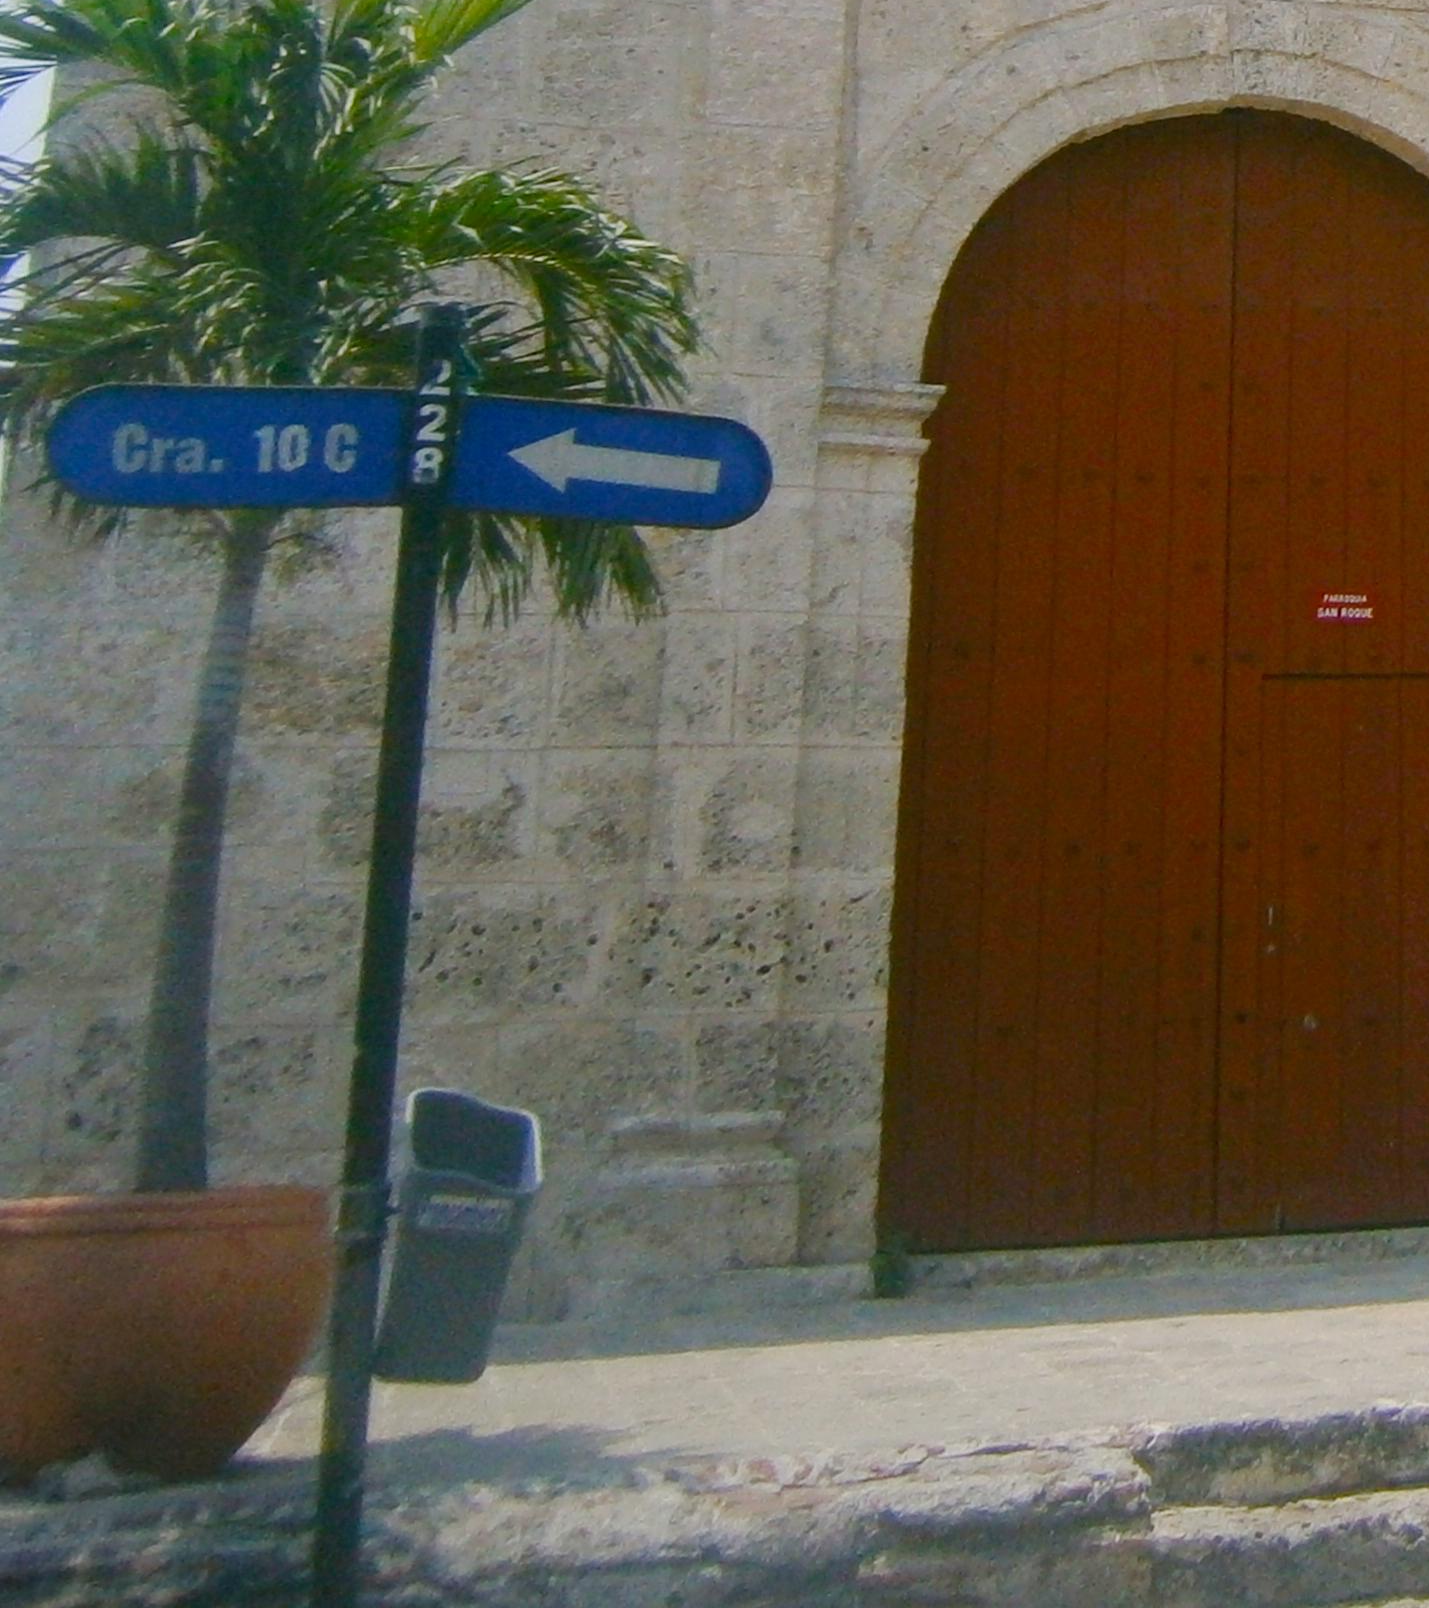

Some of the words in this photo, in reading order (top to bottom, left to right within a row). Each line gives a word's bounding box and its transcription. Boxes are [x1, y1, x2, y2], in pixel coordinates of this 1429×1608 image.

[112, 422, 225, 473] Cra.
[254, 423, 312, 473] 10
[323, 422, 359, 473] C
[1317, 607, 1339, 618] SAN
[1340, 607, 1374, 618] ROQUE
